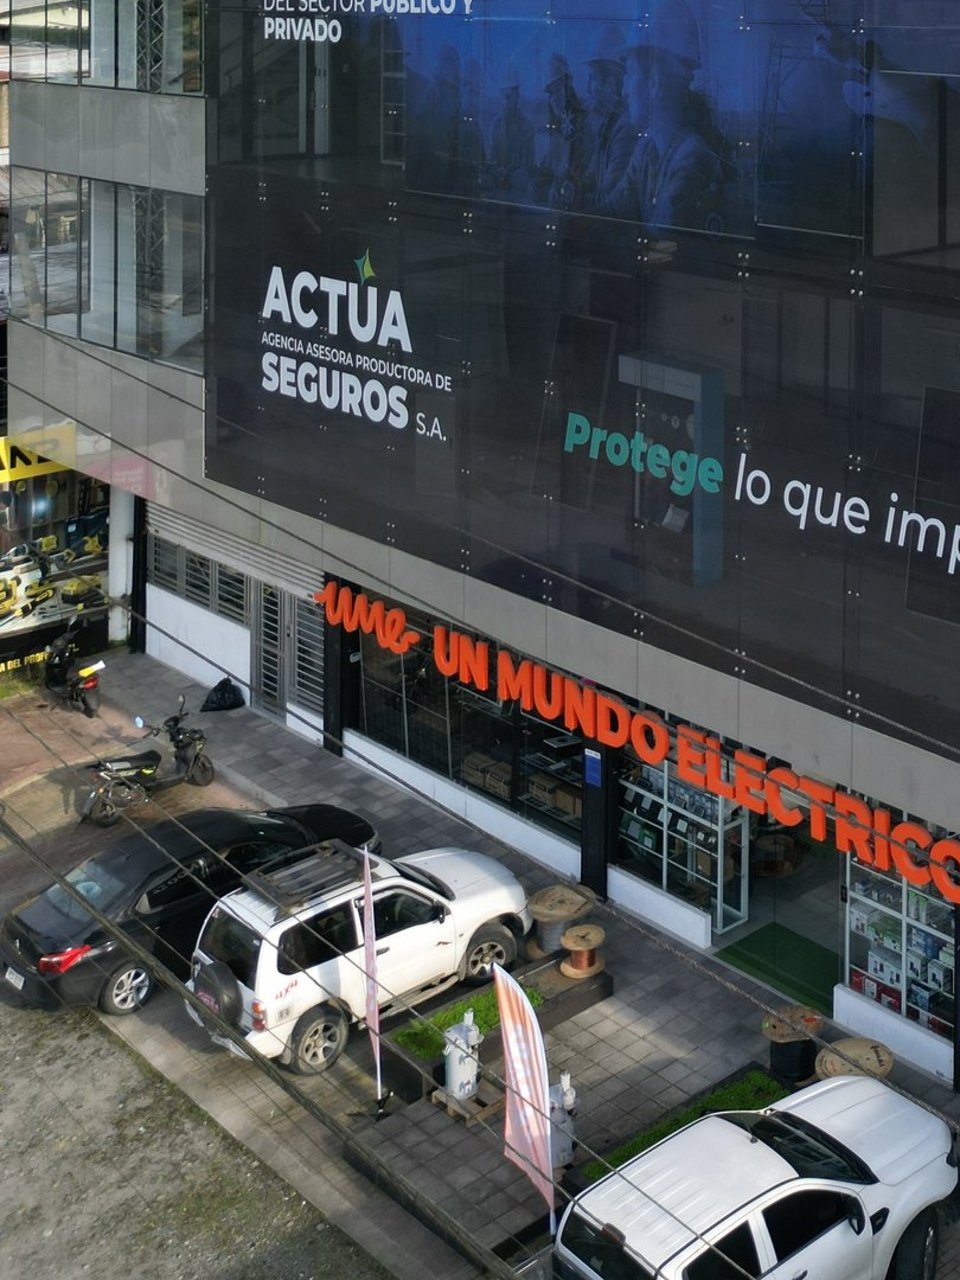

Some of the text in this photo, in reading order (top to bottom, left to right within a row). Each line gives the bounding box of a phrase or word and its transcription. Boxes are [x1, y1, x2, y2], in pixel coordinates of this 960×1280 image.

[264, 17, 342, 43] PRIVADO
[261, 331, 452, 392] AGENCIA ASESORA PRODUCTORA DE
[261, 351, 447, 441] SEGUROS S.A.
[564, 412, 724, 497] Protege
[734, 452, 771, 505] lo
[783, 478, 870, 529] que
[433, 625, 489, 691] UN
[496, 650, 670, 766] MUNDO
